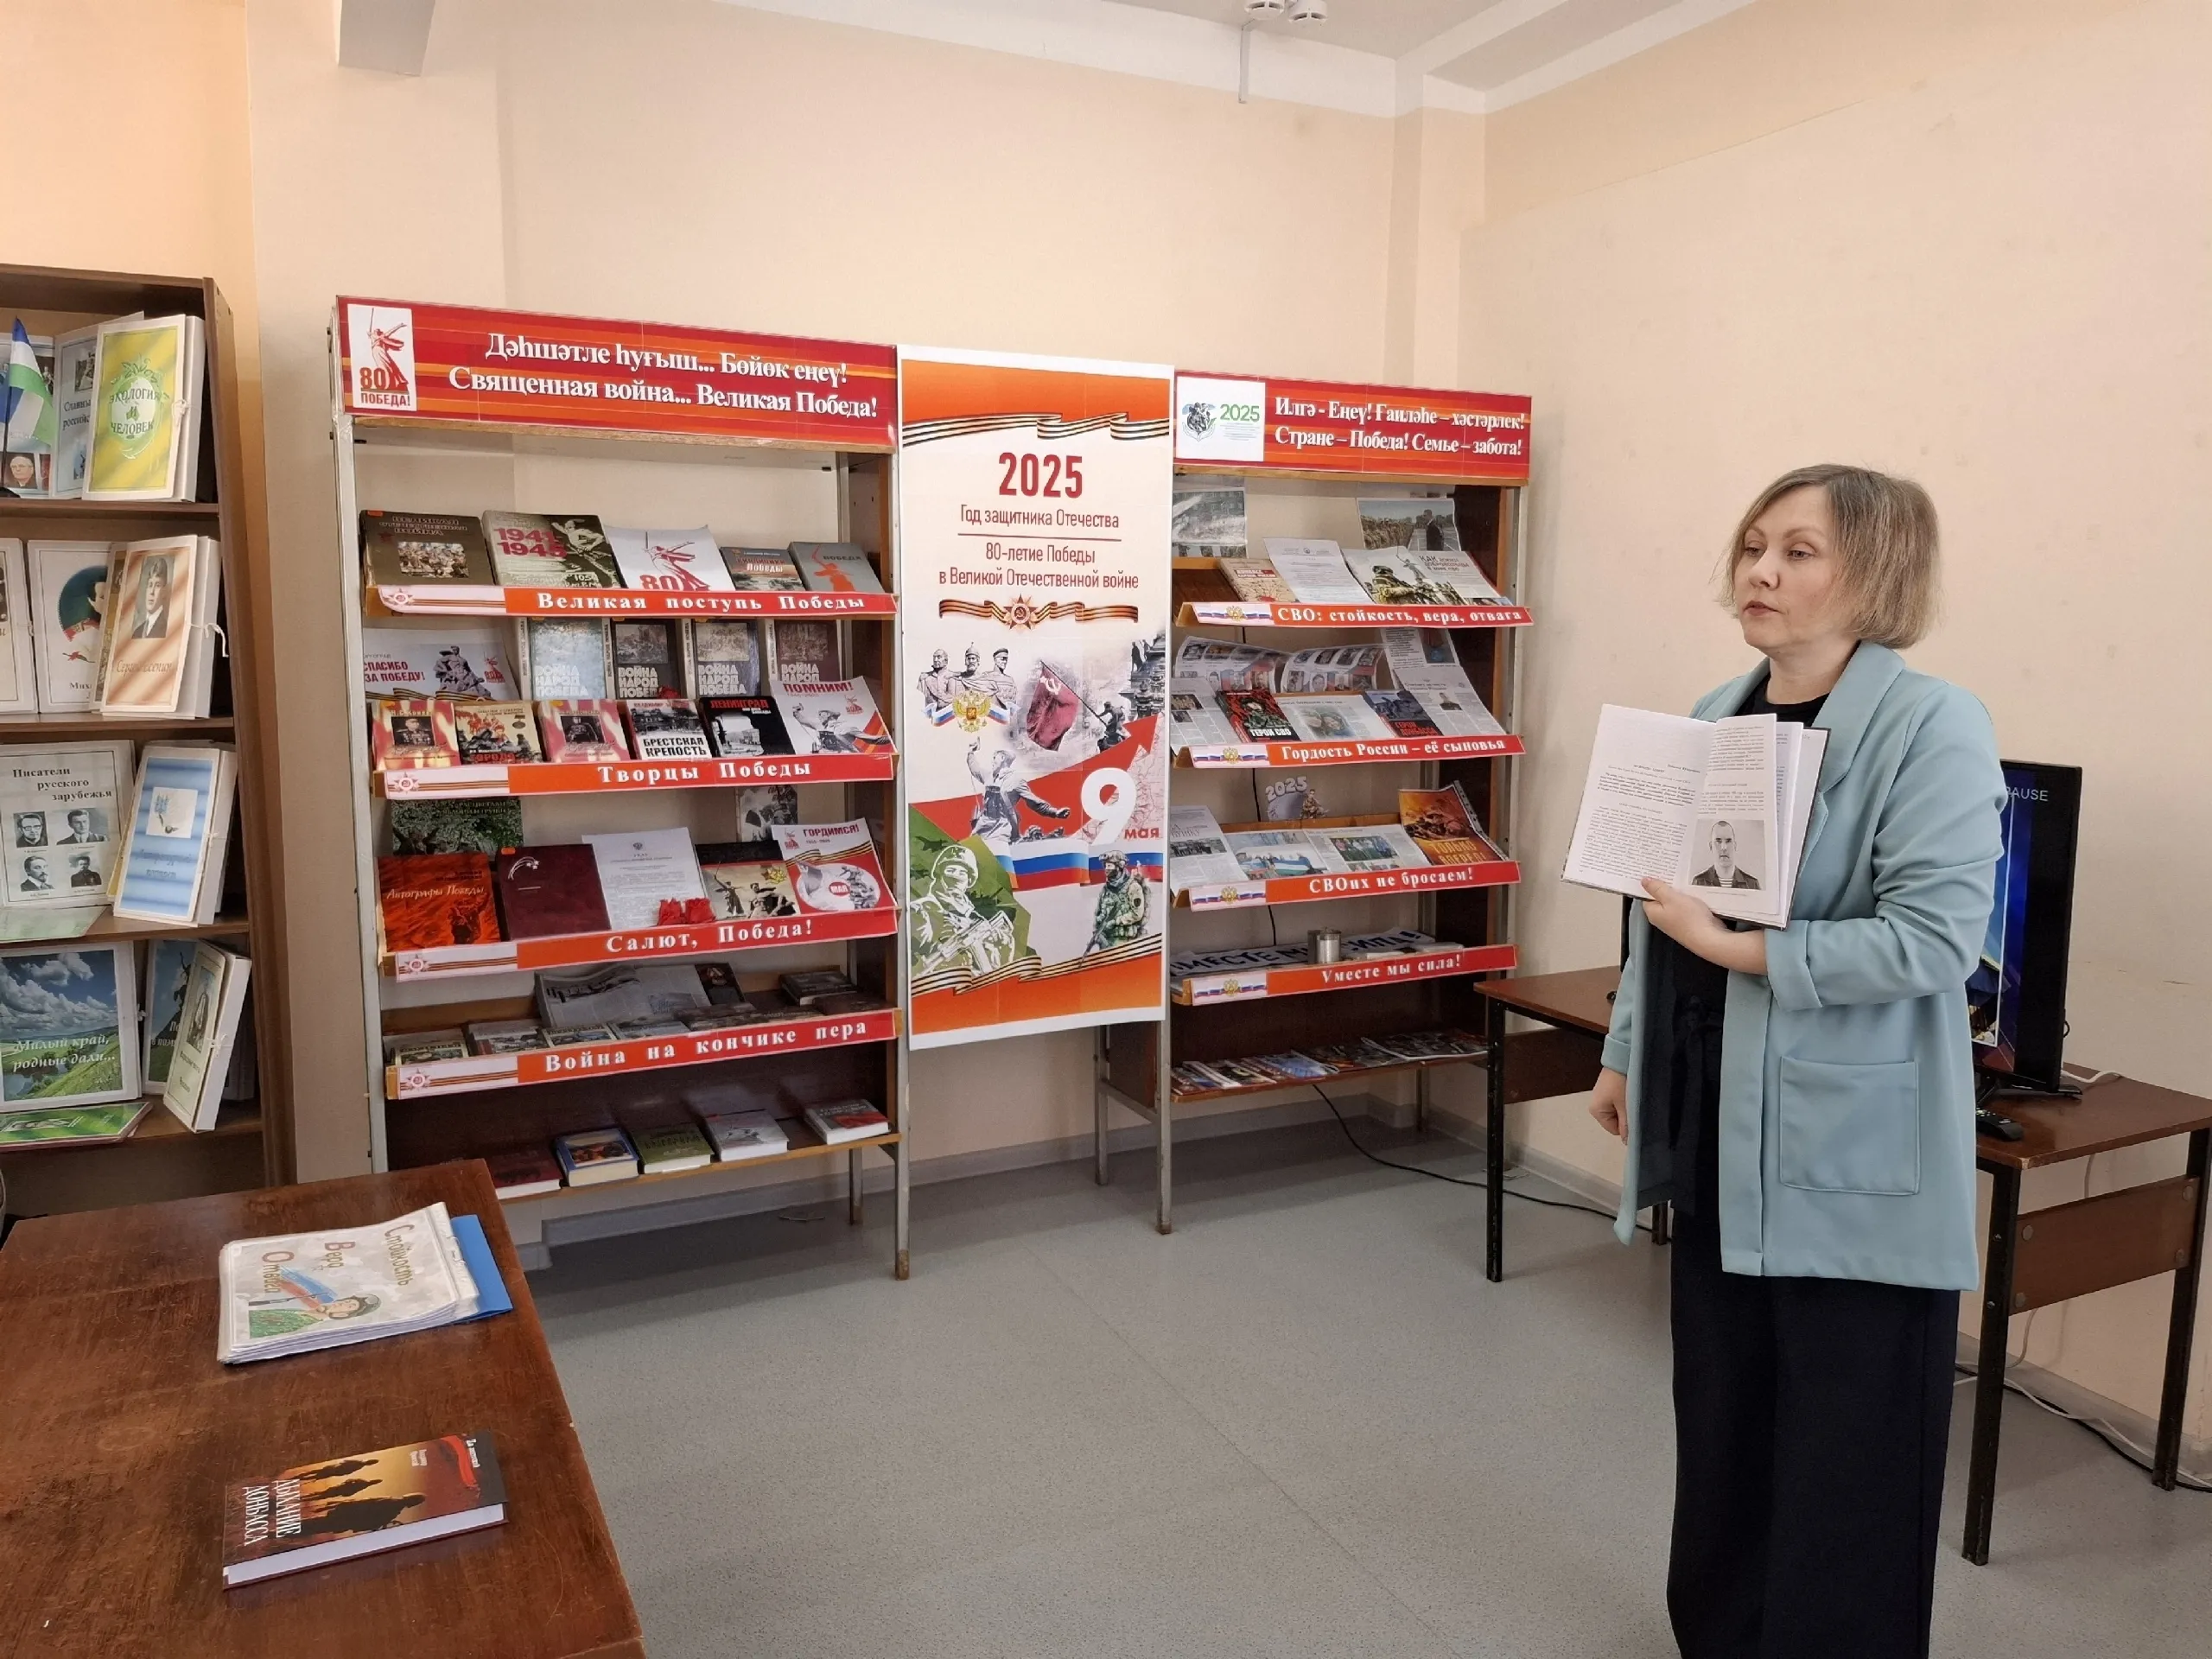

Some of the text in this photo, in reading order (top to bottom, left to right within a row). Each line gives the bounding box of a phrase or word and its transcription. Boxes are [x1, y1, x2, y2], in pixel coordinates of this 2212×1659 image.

[486, 333, 610, 363] Дәһшәтле
[720, 352, 790, 379] Бөйөк
[359, 367, 387, 390] 80
[109, 388, 161, 404] ЭКОЛОГИЯ
[361, 392, 411, 406] ПОБЕДА!
[449, 366, 877, 418] Священная война... Великая Победа!
[1220, 404, 1261, 423] 2025
[1274, 397, 1316, 417] Илгә
[1328, 401, 1372, 425] Еңеү!
[1376, 404, 1437, 424] Ғаиләһе
[1452, 413, 1525, 432] хәстәрлек!
[111, 421, 154, 435] ЧЕЛОВЕК
[1274, 425, 1334, 450] Стране
[1349, 429, 1408, 451] Победа!
[1412, 433, 1459, 453] Семье
[1472, 438, 1522, 455] забота!
[999, 452, 1083, 498] 2025
[961, 505, 1119, 528] Год защитника Отечества
[497, 542, 568, 558] 1945
[986, 543, 1095, 565] 80-летие Победы
[939, 567, 1139, 588] в Великой Отечественной войне
[537, 592, 865, 613] Великая поступь Победы
[1277, 607, 1522, 625] СВО: стойкость, вера, отвага
[364, 671, 426, 683] ЗА ПОБЕДУ!
[535, 664, 580, 676] ВОЙНА
[618, 665, 658, 677] ВОЙНА
[698, 663, 739, 675] ВОЙНА
[781, 662, 819, 674] ВОЙНА
[536, 676, 581, 686] НАРОД
[619, 677, 658, 688] НАРОД
[699, 675, 740, 685] НАРОД
[781, 674, 820, 683] НАРОД
[783, 682, 854, 693] ПОМНИМ!
[536, 686, 588, 697] ПОБЕДА
[699, 684, 747, 696] ПОБЕДА
[710, 699, 768, 709] ЛЕНИНГРАД
[643, 736, 704, 747] БРЕСТСКАЯ
[1281, 746, 1352, 761] Гордость
[1357, 743, 1408, 756] России
[1424, 741, 1440, 754] её
[1443, 738, 1506, 753] сыновья
[645, 746, 707, 756] КРЕПОСТЬ
[13, 767, 71, 778] Писатели
[598, 761, 810, 785] Творцы Победы
[37, 779, 90, 791] русского
[1264, 776, 1307, 802] 2025
[52, 790, 112, 802] зарубежья
[1080, 767, 1160, 845] 9 мая
[804, 823, 860, 837] ГОРДИМСЯ!
[1433, 841, 1477, 854] ТОЛЬКО
[1309, 867, 1473, 894] СВОих не бросаем!
[386, 884, 484, 900] Автографы Победы
[607, 920, 812, 953] Салют, Победа!
[1387, 963, 1411, 977] мы
[1418, 955, 1461, 973] сила!
[15, 1034, 110, 1052] Милый край,
[545, 1020, 868, 1071] Война на кончике пера
[13, 1052, 116, 1072] родные дали...
[325, 1241, 356, 1268] Вера
[385, 1224, 415, 1286] Стойкость
[262, 1251, 295, 1294] Отвага
[242, 1485, 269, 1547] ДОНБАССА
[273, 1478, 302, 1538] ДЫХАНИЕ
